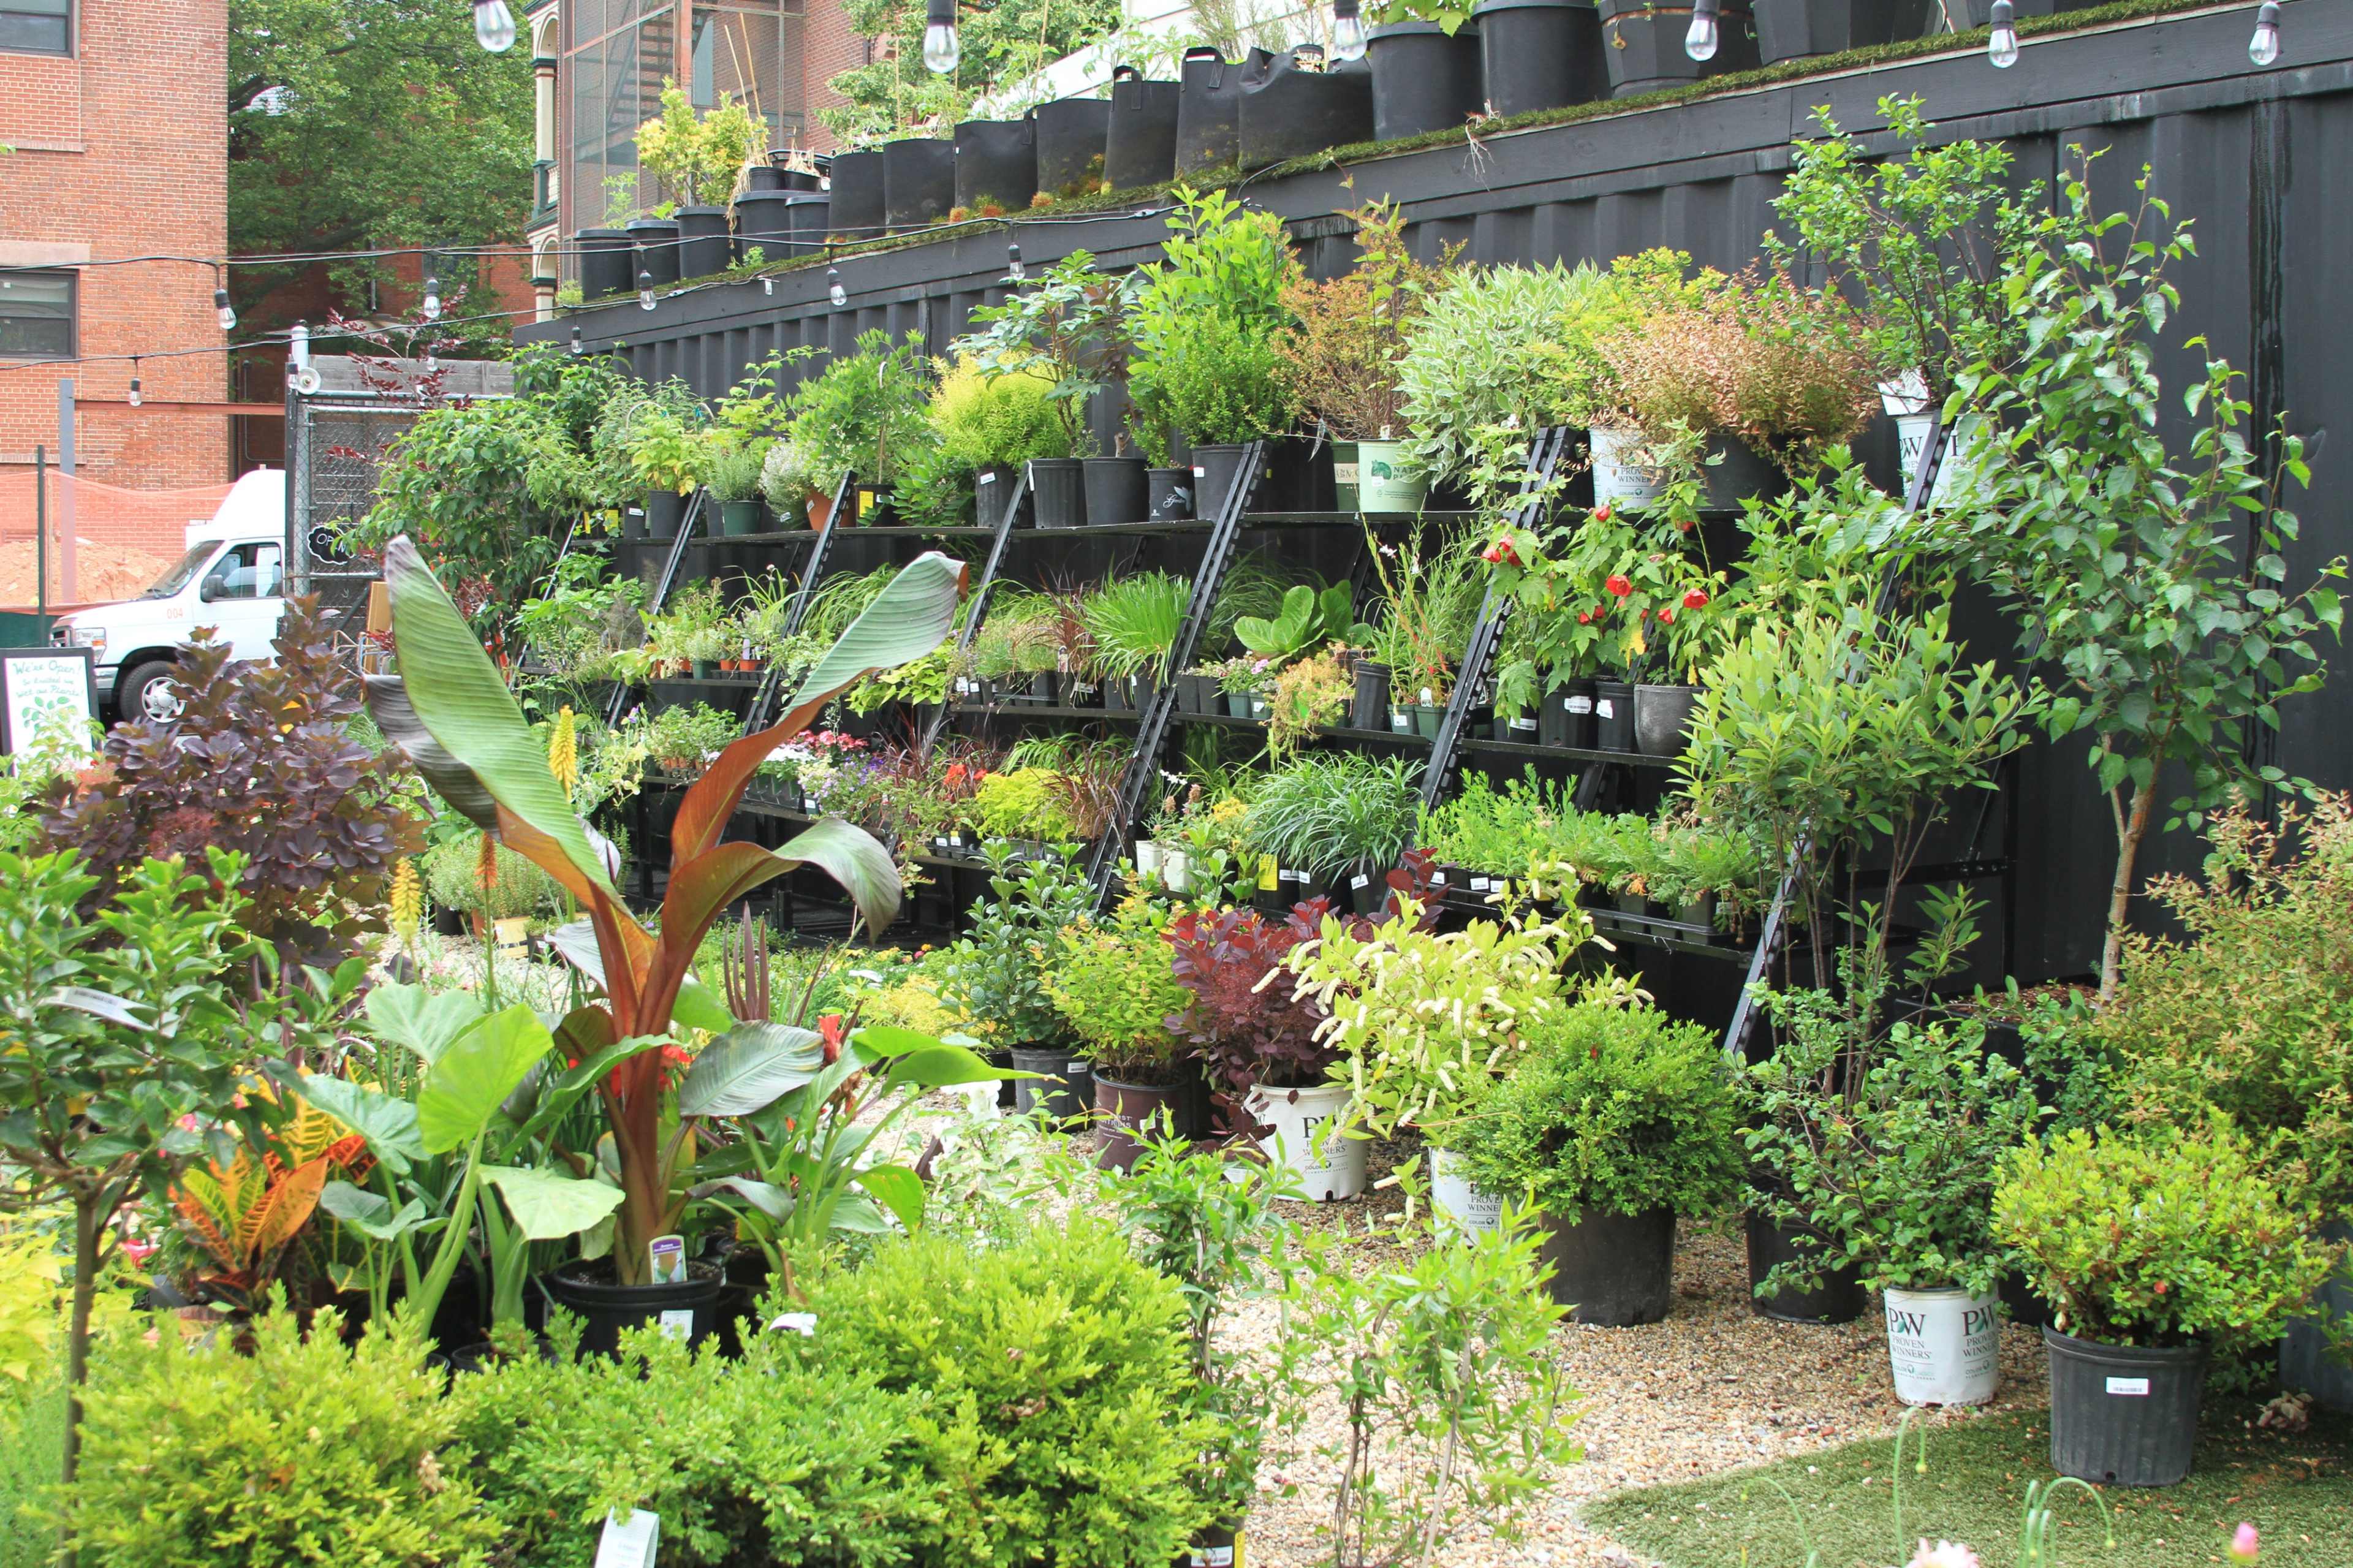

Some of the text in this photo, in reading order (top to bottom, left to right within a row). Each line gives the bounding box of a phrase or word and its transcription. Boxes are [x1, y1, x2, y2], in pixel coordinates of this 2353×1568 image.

[317, 534, 347, 553] OPN
[167, 608, 183, 619] 004
[1306, 1138, 1343, 1148] POVN
[1303, 1145, 1346, 1156] WNERS
[1888, 1307, 1927, 1337] PW
[1892, 1336, 1925, 1349] PROVEN
